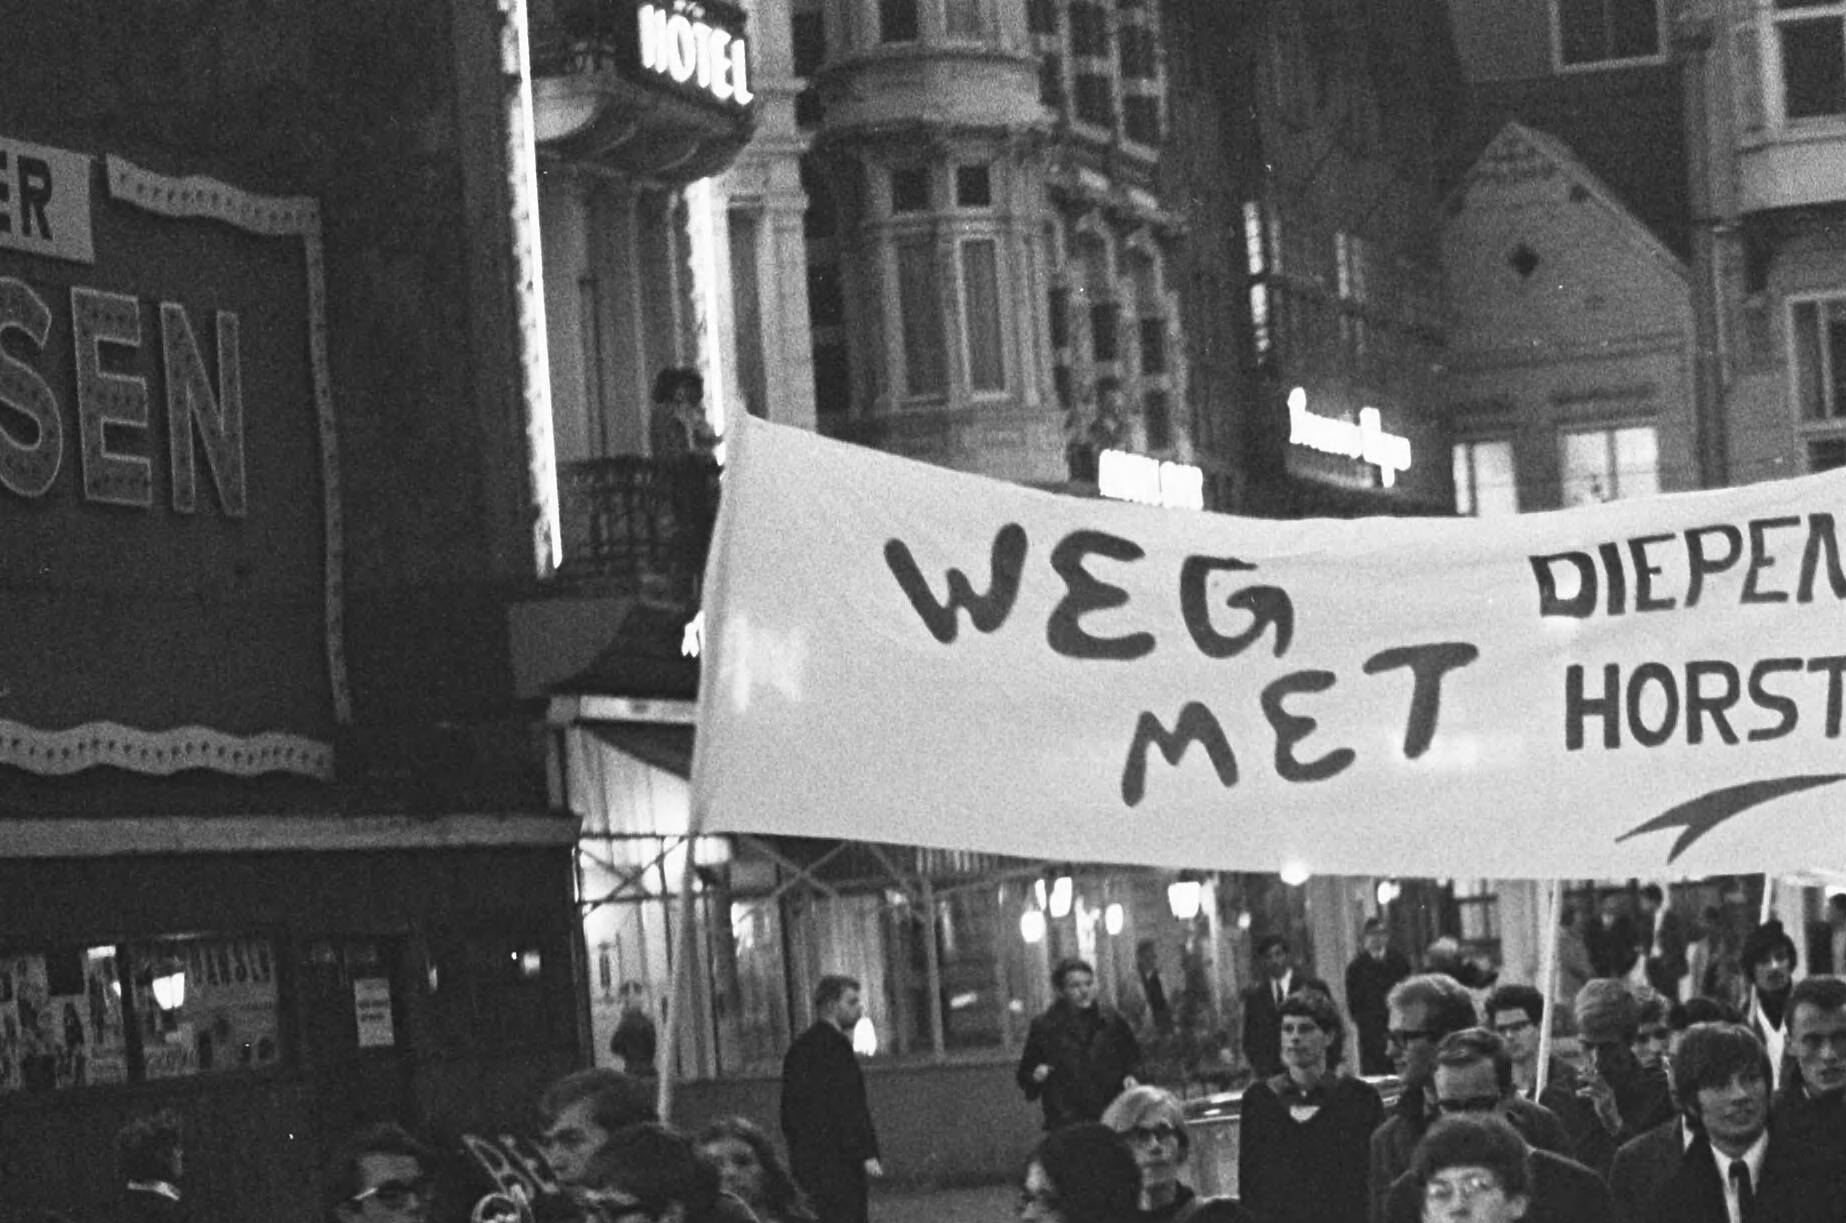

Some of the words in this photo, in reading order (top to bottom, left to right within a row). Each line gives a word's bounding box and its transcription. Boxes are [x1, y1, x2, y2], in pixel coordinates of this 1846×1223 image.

[638, 4, 754, 106] HOTEL
[0, 276, 247, 518] SEN
[884, 523, 1294, 661] WEG
[1121, 641, 1480, 807] MET
